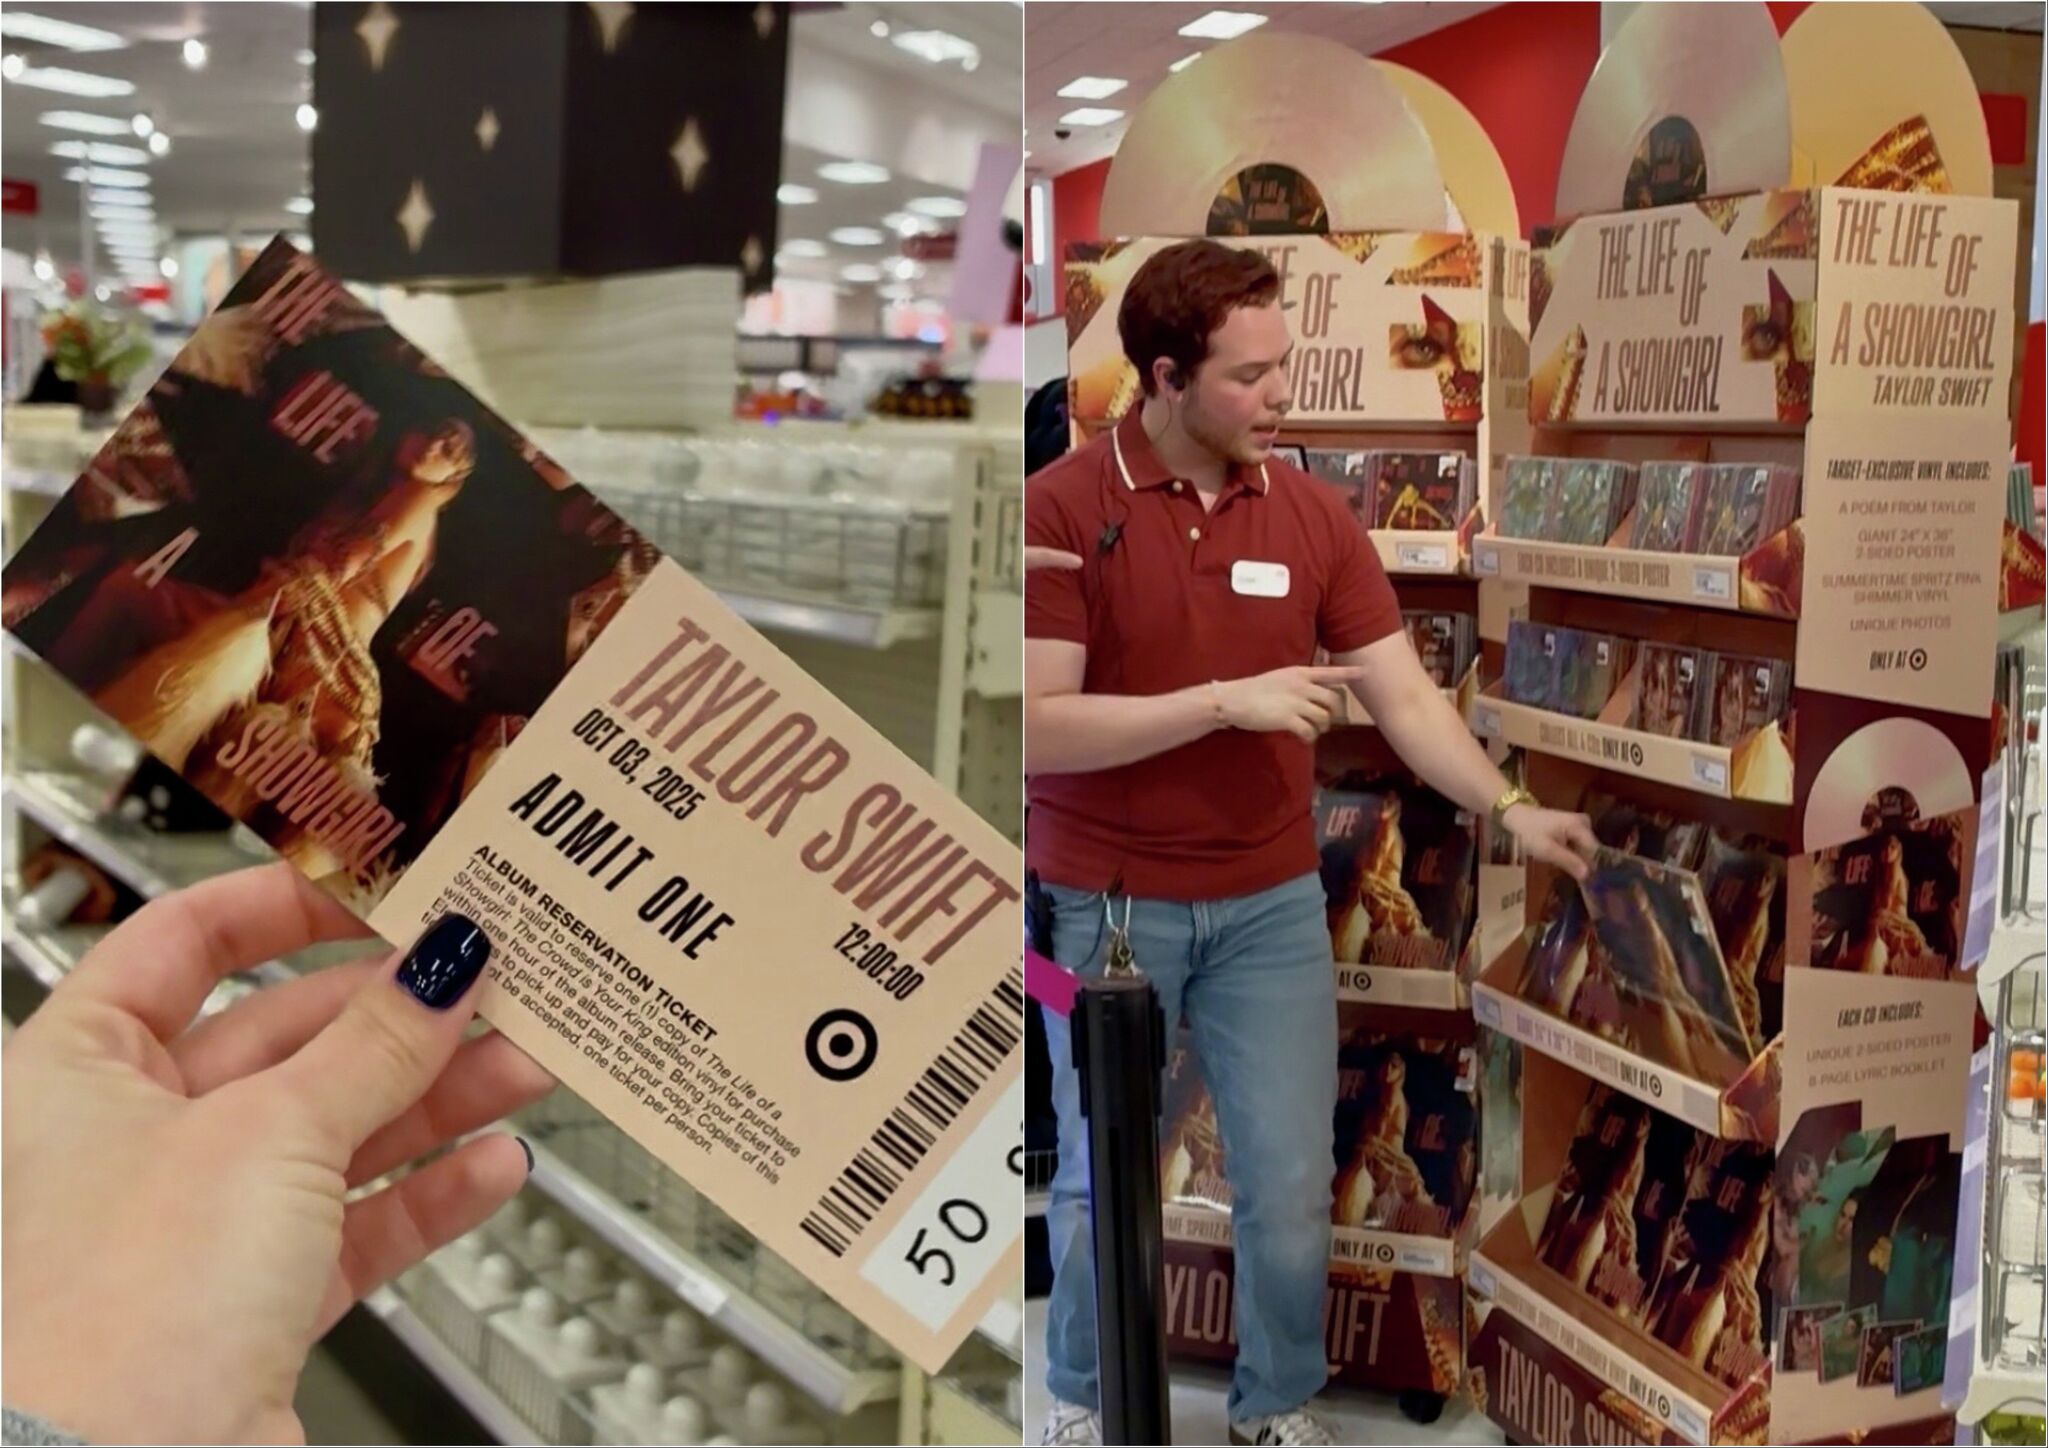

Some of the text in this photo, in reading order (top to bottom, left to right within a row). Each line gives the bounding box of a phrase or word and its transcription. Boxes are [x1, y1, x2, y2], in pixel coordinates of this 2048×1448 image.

[1597, 217, 1681, 299] THE LIFE
[1833, 198, 1947, 268] THE LIFE
[1944, 234, 1982, 297] OF
[1301, 273, 1341, 338] OF
[1679, 247, 1711, 326] OF
[1830, 302, 1996, 370] A SHOWGIRL
[1287, 347, 1365, 412] GIRL
[1593, 341, 1610, 412] A
[1613, 334, 1723, 414] SHOWGIRL
[1873, 375, 1993, 407] TAYLOR SWIFT
[271, 369, 380, 464] LIFE
[1839, 500, 1976, 514] A POEM FROM TAYLOR
[1858, 529, 1897, 542] GIANT
[133, 527, 198, 588] A
[1907, 545, 1956, 558] POSTER
[1850, 616, 1951, 631] UNIQUE PHOTOS
[1869, 650, 1907, 670] ONLY AT
[215, 714, 407, 876] SHOWGIRL
[571, 708, 706, 821] OCT 03, 2025
[609, 617, 1023, 967] TAYLOR SWIFT
[1326, 805, 1359, 837] LIFE
[508, 772, 735, 960] ADMIT ONE
[1845, 855, 1872, 885] LIFE
[473, 844, 718, 1042] ALBUM RESERVATION TICKET
[833, 922, 925, 1001] 12:00:00
[452, 870, 512, 922] Showgirl:
[512, 917, 538, 944] The
[536, 939, 583, 979] Crowd
[577, 973, 593, 989] is
[592, 982, 624, 1012] Your
[620, 1007, 653, 1039] King
[651, 1034, 696, 1073] edition
[694, 1068, 727, 1096] vinyl
[723, 1089, 744, 1110] for
[739, 1107, 801, 1158] purchase
[464, 856, 782, 1121] Ticket is valid to reserve one (1) copy of The Life of a
[1837, 1008, 1862, 1029] EACH
[442, 885, 482, 922] within
[480, 918, 508, 942] one
[507, 936, 540, 967] hour
[538, 964, 558, 980] of
[553, 974, 578, 999] the
[576, 995, 619, 1032] album
[617, 1028, 666, 1072] release.
[668, 1067, 710, 1105] Bring
[701, 1098, 736, 1125] your
[733, 1120, 771, 1155] ticket
[769, 1149, 786, 1167] to
[1807, 1046, 1855, 1063] UNIQUE
[1904, 1032, 1952, 1049] POSTER
[500, 975, 713, 1154] be accepted, one ticket per person.
[500, 953, 780, 1185] to pick up and pay for your copy. Copies of this
[1820, 1072, 1850, 1086] PAGE
[1854, 1066, 1888, 1082] LYRIC
[1890, 1058, 1946, 1077] BOOKLET
[904, 1199, 989, 1286] 50
[1333, 1238, 1358, 1258] ONLY
